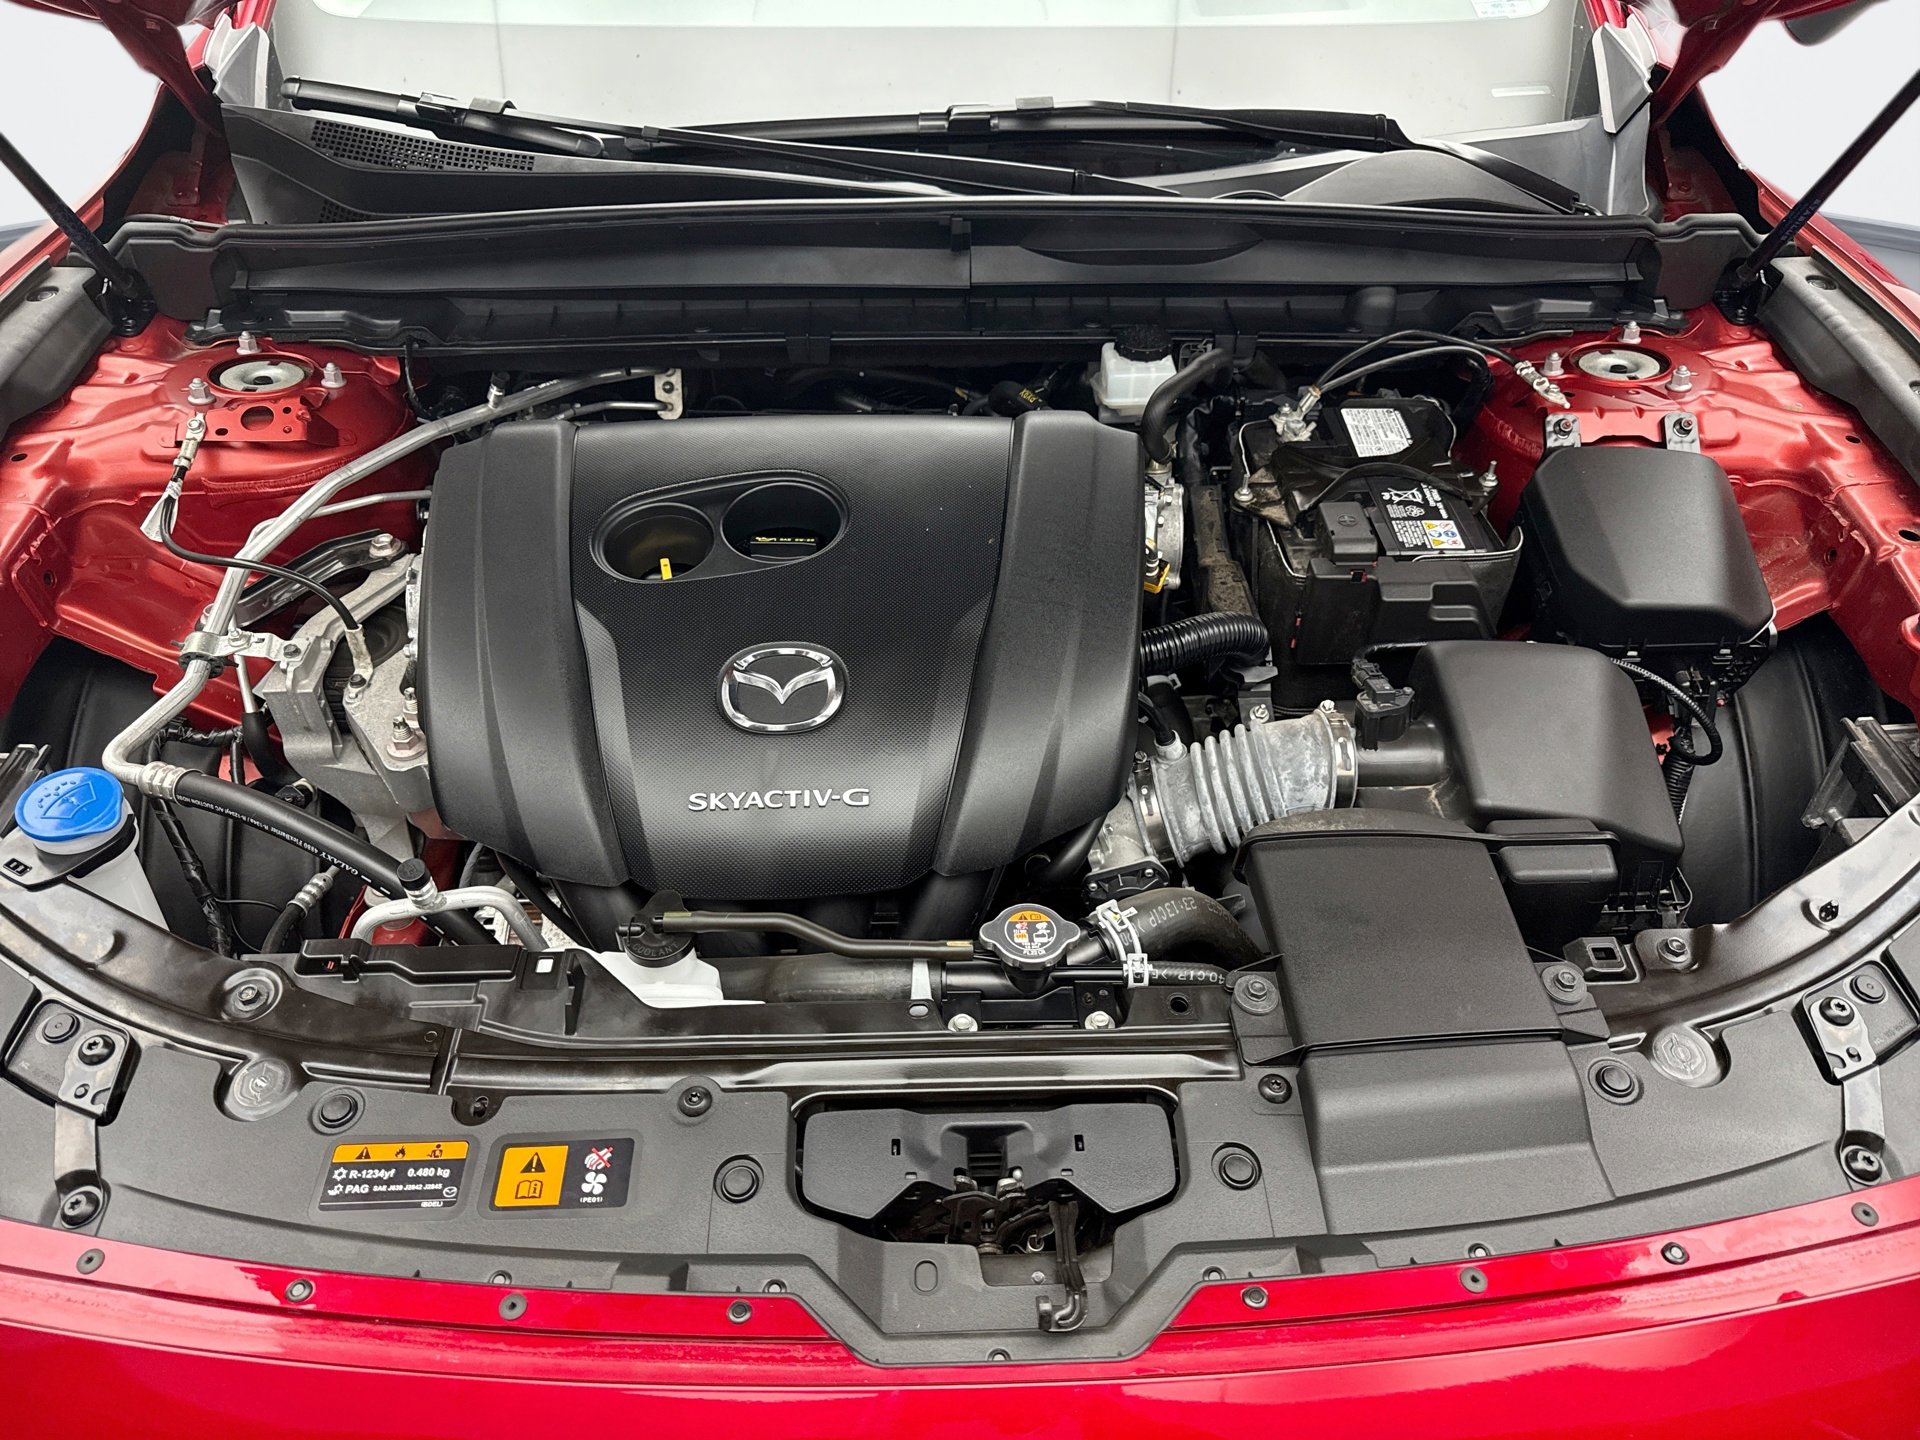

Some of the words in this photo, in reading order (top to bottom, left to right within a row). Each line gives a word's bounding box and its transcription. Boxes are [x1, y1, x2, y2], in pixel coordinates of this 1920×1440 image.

[688, 788, 870, 811] SKYACTIV-G
[320, 851, 359, 876] GALAXY
[631, 941, 679, 957] COOLANT
[348, 1168, 396, 1180] R-1234yf
[407, 1168, 435, 1177] 0.480
[436, 1167, 451, 1178] kg
[344, 1184, 370, 1194] PAG
